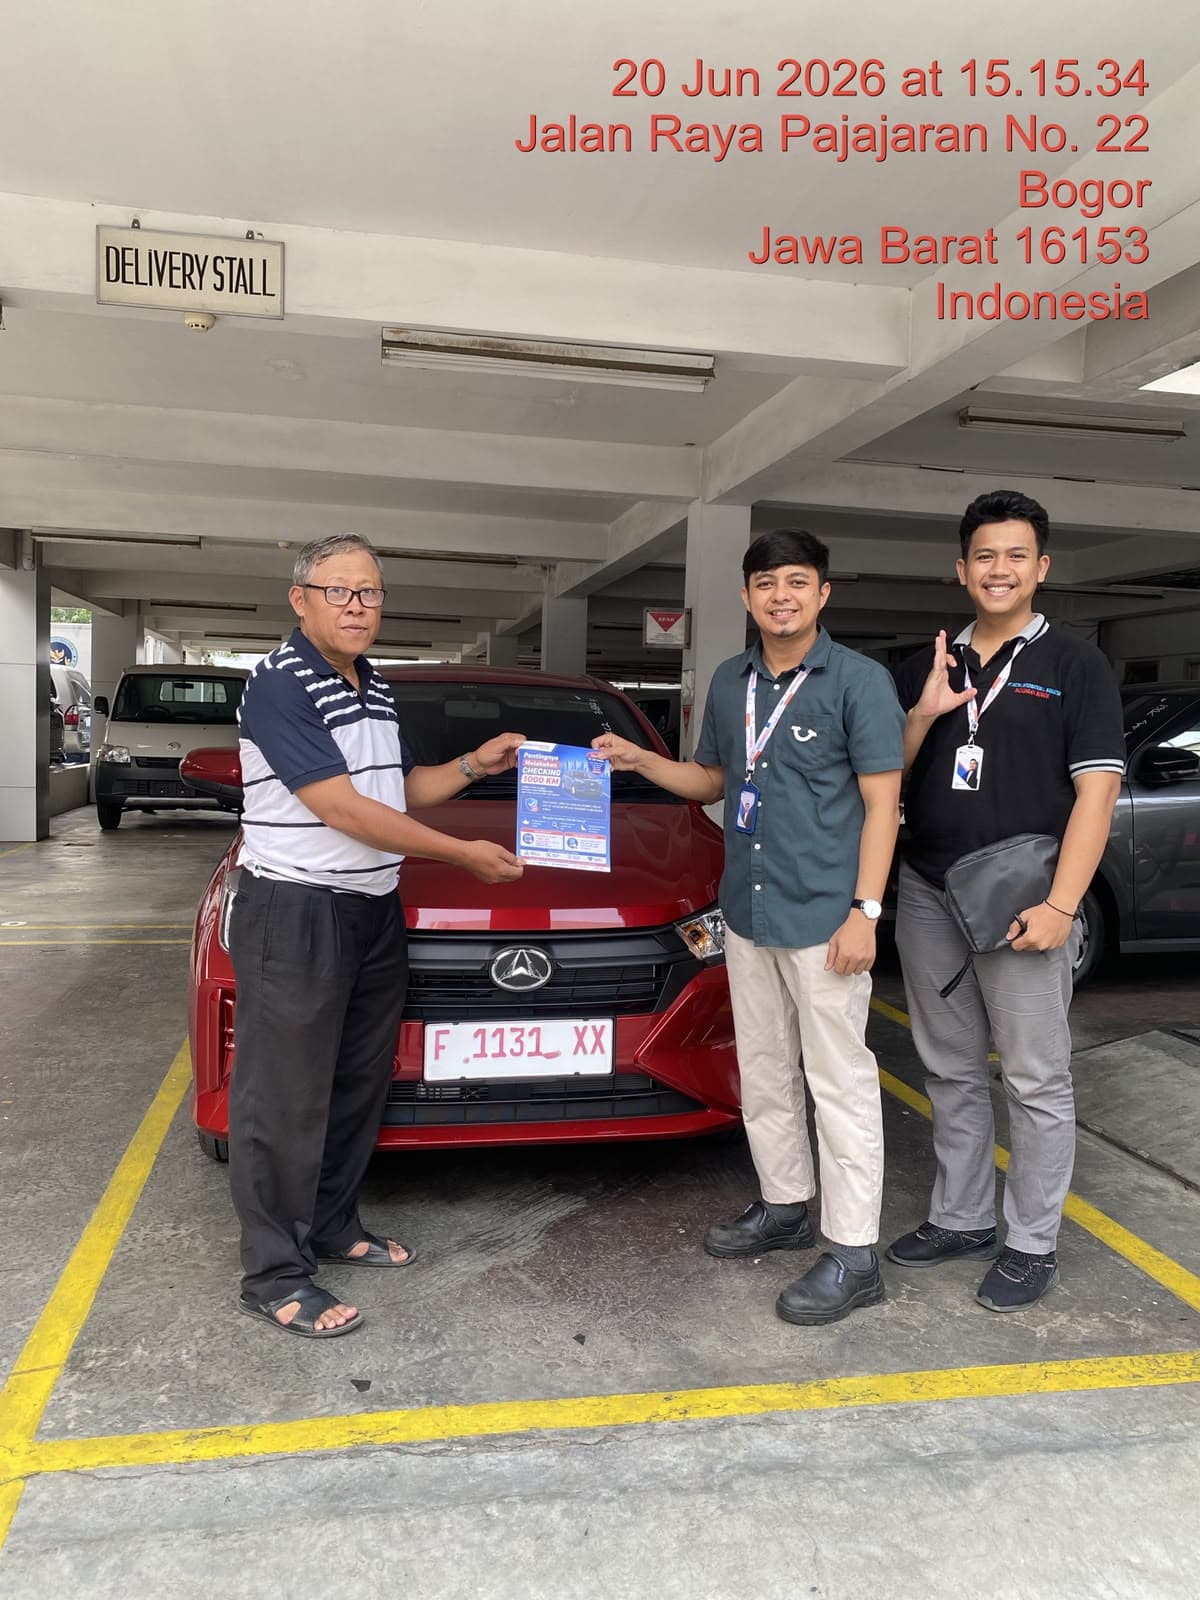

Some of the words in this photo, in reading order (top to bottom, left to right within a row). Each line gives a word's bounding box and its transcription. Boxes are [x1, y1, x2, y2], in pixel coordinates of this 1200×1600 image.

[212, 255, 276, 297] STALL
[522, 766, 561, 777] CHECKING
[523, 775, 545, 784] 1000
[546, 777, 560, 785] KM
[433, 1029, 450, 1061] F
[572, 1024, 607, 1056] XX
